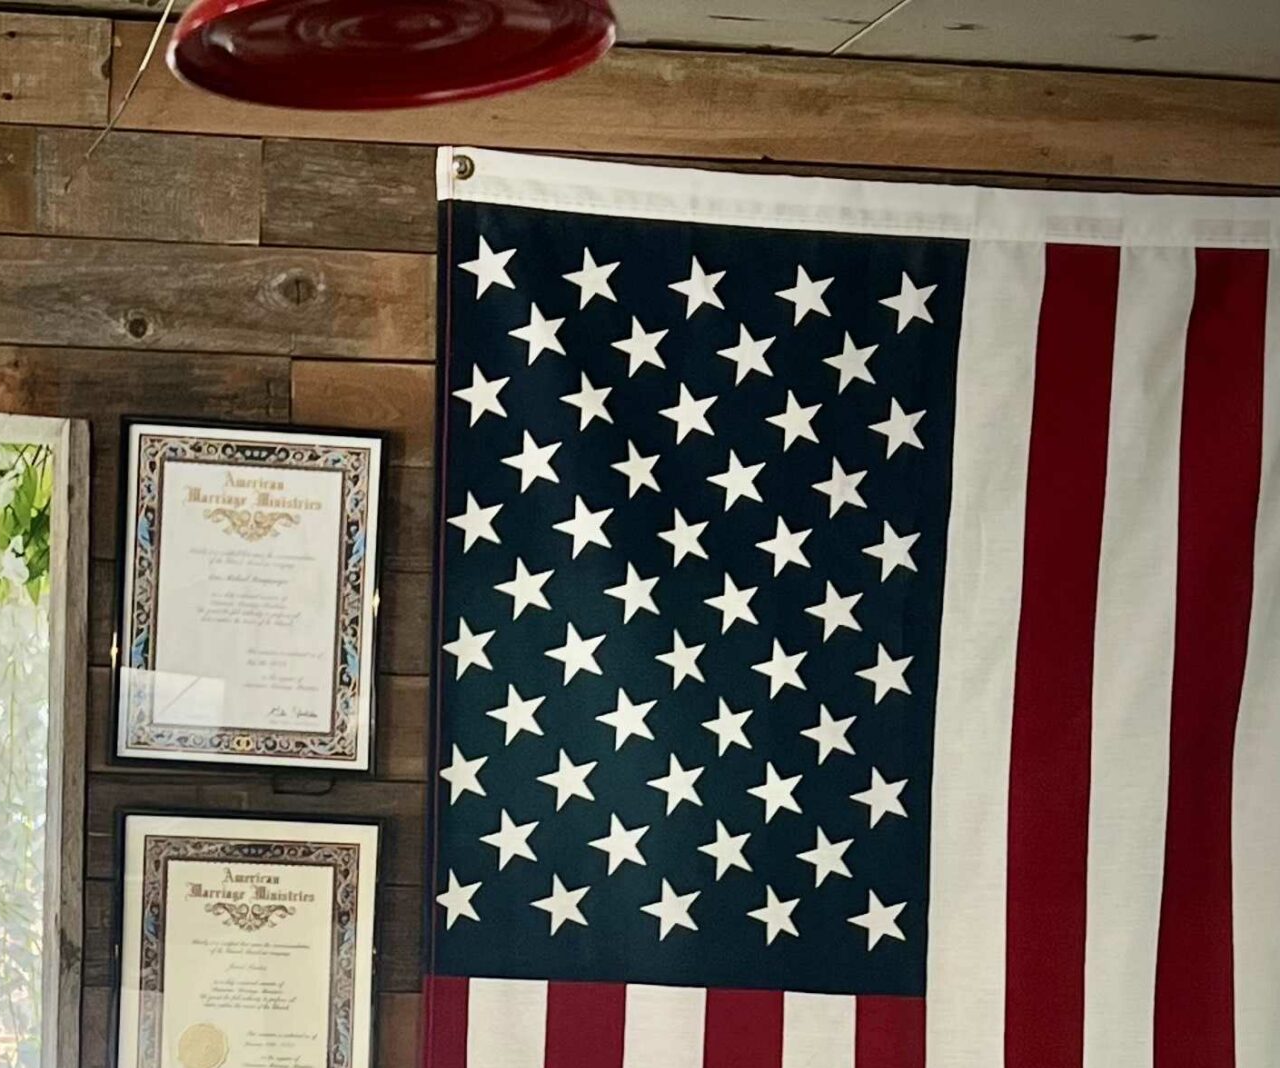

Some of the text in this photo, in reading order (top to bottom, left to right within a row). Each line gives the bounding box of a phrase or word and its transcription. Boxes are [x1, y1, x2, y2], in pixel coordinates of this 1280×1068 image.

[224, 471, 285, 490] American
[184, 485, 322, 510] Marriage Ministries
[222, 866, 280, 885] American
[186, 882, 315, 903] Marriage Ministries
